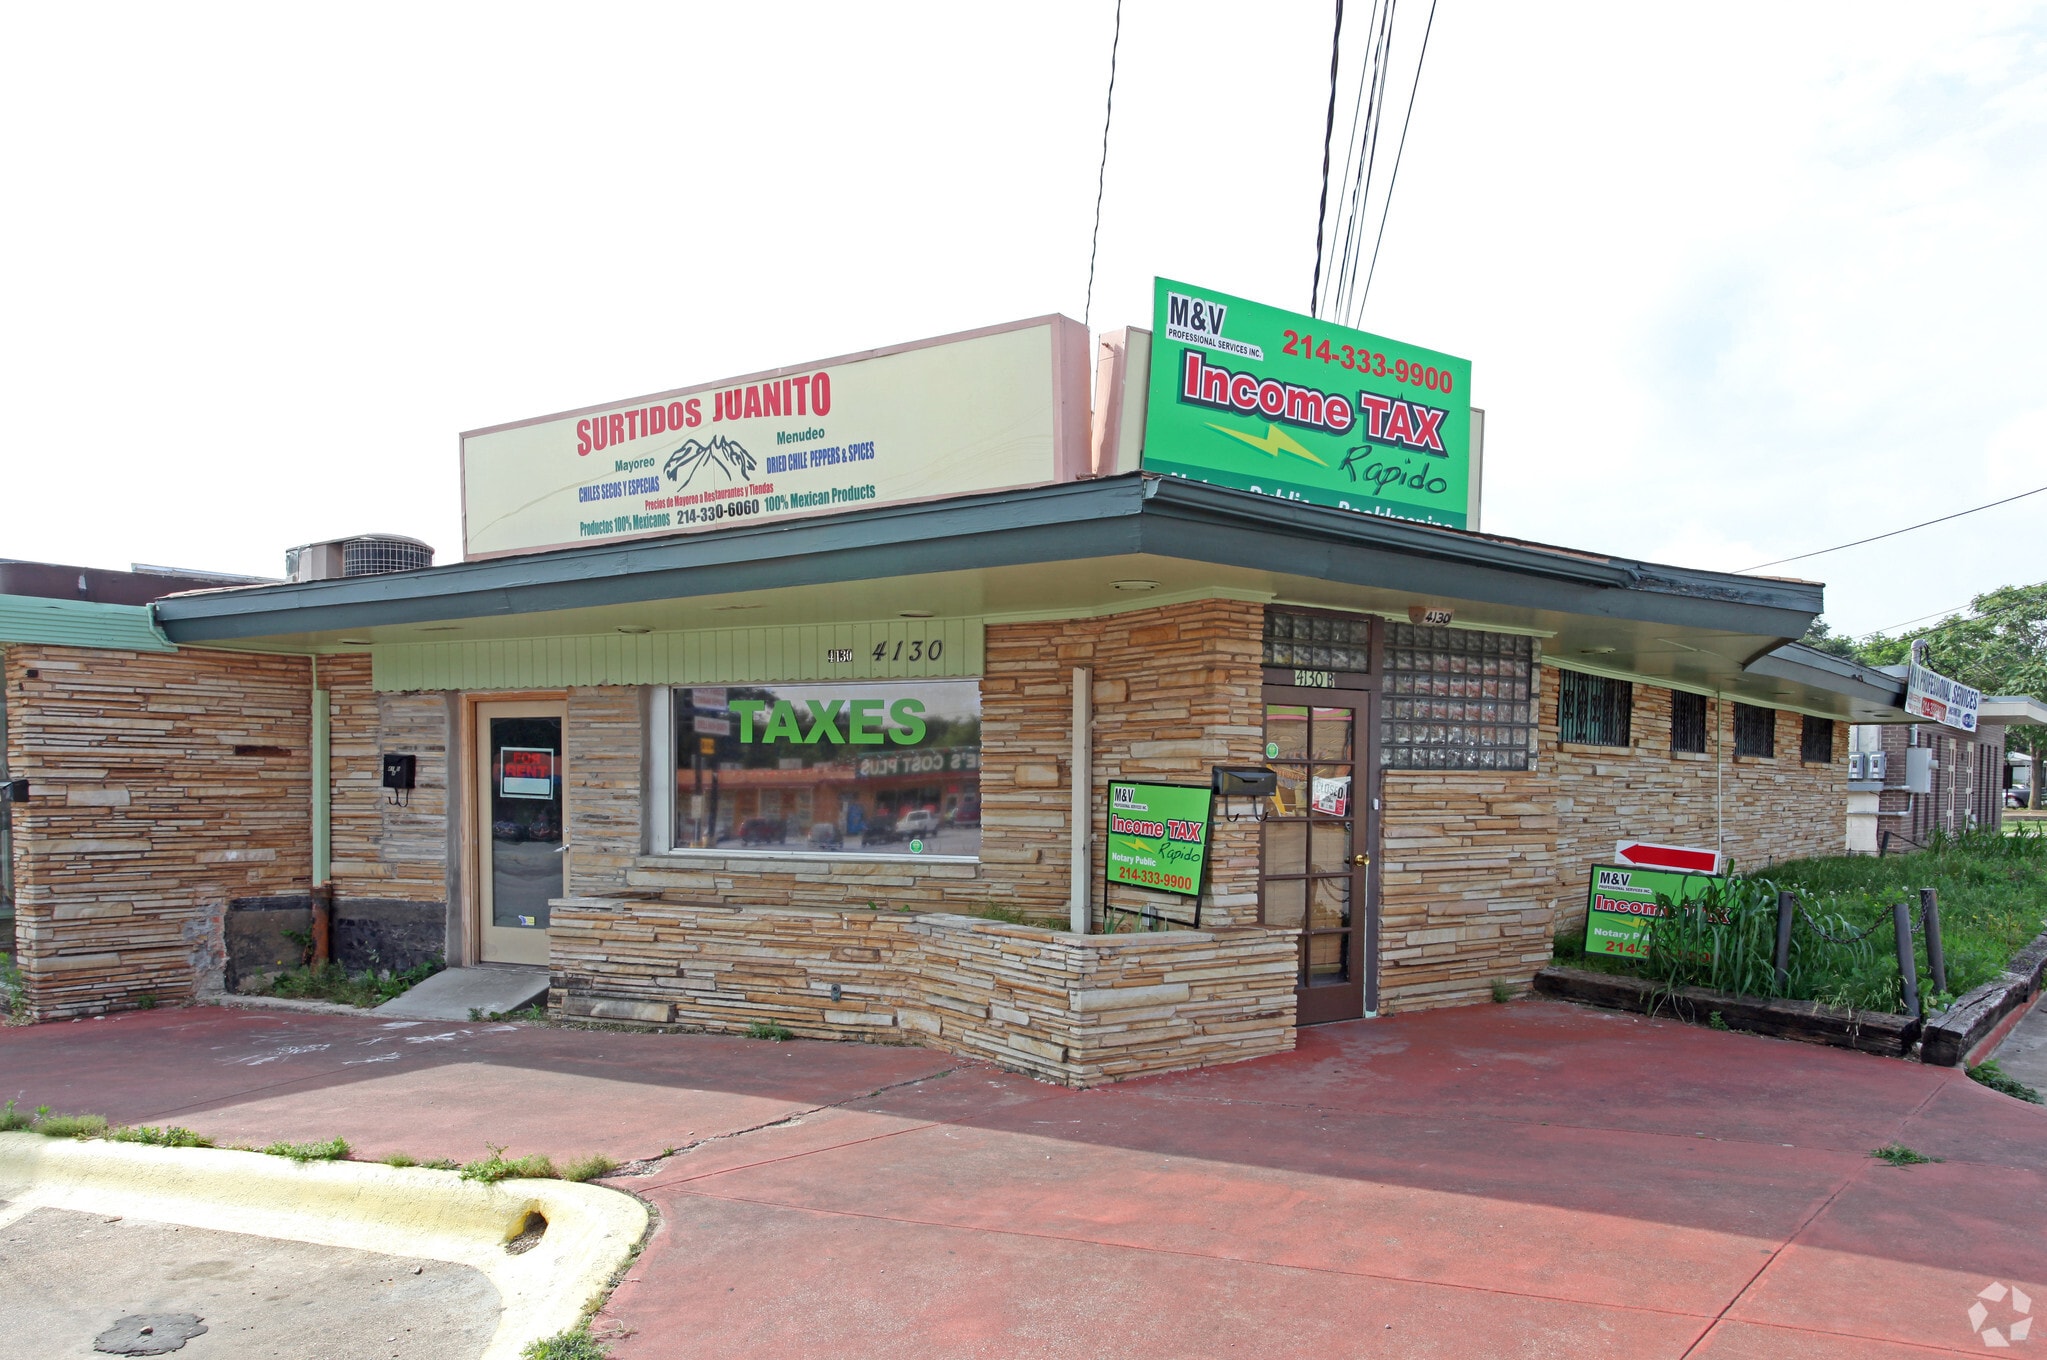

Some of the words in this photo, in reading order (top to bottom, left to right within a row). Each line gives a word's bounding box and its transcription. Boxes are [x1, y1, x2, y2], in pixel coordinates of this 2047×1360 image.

[1170, 296, 1224, 335] M&V
[1168, 328, 1216, 347] PROFESSIONAL
[1217, 340, 1248, 355] SERVICES
[1248, 347, 1262, 358] INC.
[1282, 329, 1453, 394] 214-333-9900
[576, 398, 702, 457] SURTIDOS
[712, 371, 831, 423] JUANITO
[1183, 350, 1354, 433] Income
[1359, 391, 1447, 454] TAX
[776, 427, 825, 445] Menudeo
[614, 456, 655, 473] Mayoreo
[766, 455, 787, 474] DRIED
[788, 452, 808, 471] CHILE
[810, 446, 840, 468] PEPPERS
[841, 448, 847, 461] &
[848, 441, 875, 462] SPICES
[1338, 445, 1448, 496] Rapido
[578, 484, 601, 503] CHILES
[601, 482, 622, 500] SECOS
[623, 480, 628, 497] Y
[628, 475, 660, 496] ESPECIAS
[644, 498, 666, 511] Precios
[666, 497, 674, 508] de
[674, 494, 699, 507] Mayoreo
[699, 495, 704, 503] a
[704, 487, 744, 502] Restaurantes
[744, 486, 749, 497] y
[749, 482, 774, 496] Tiendas
[764, 494, 789, 512] 100%
[790, 489, 830, 509] Mexican
[831, 484, 876, 502] Products
[677, 499, 760, 524] 214-330-6060
[580, 520, 613, 537] Productos
[614, 514, 632, 533] 100%
[632, 513, 670, 531] Mexicanos
[1425, 611, 1452, 624] 4130
[828, 649, 852, 663] 4130
[872, 639, 944, 662] 4130
[1296, 670, 1324, 687] 4130
[1952, 684, 1978, 710] SERVICES
[728, 698, 927, 745] TAXES
[513, 751, 541, 764] FOR
[505, 764, 548, 778] RENT
[1115, 787, 1134, 803] M&V
[1112, 813, 1164, 838] Income
[1167, 819, 1202, 842] TAX
[1112, 852, 1134, 866] Notary
[1135, 855, 1157, 867] Public
[1158, 842, 1200, 865] Rapido
[1119, 866, 1192, 890] 214-333-9900
[1600, 871, 1630, 886] M&V
[1595, 894, 1677, 917] Incom
[1594, 927, 1630, 940] Notary
